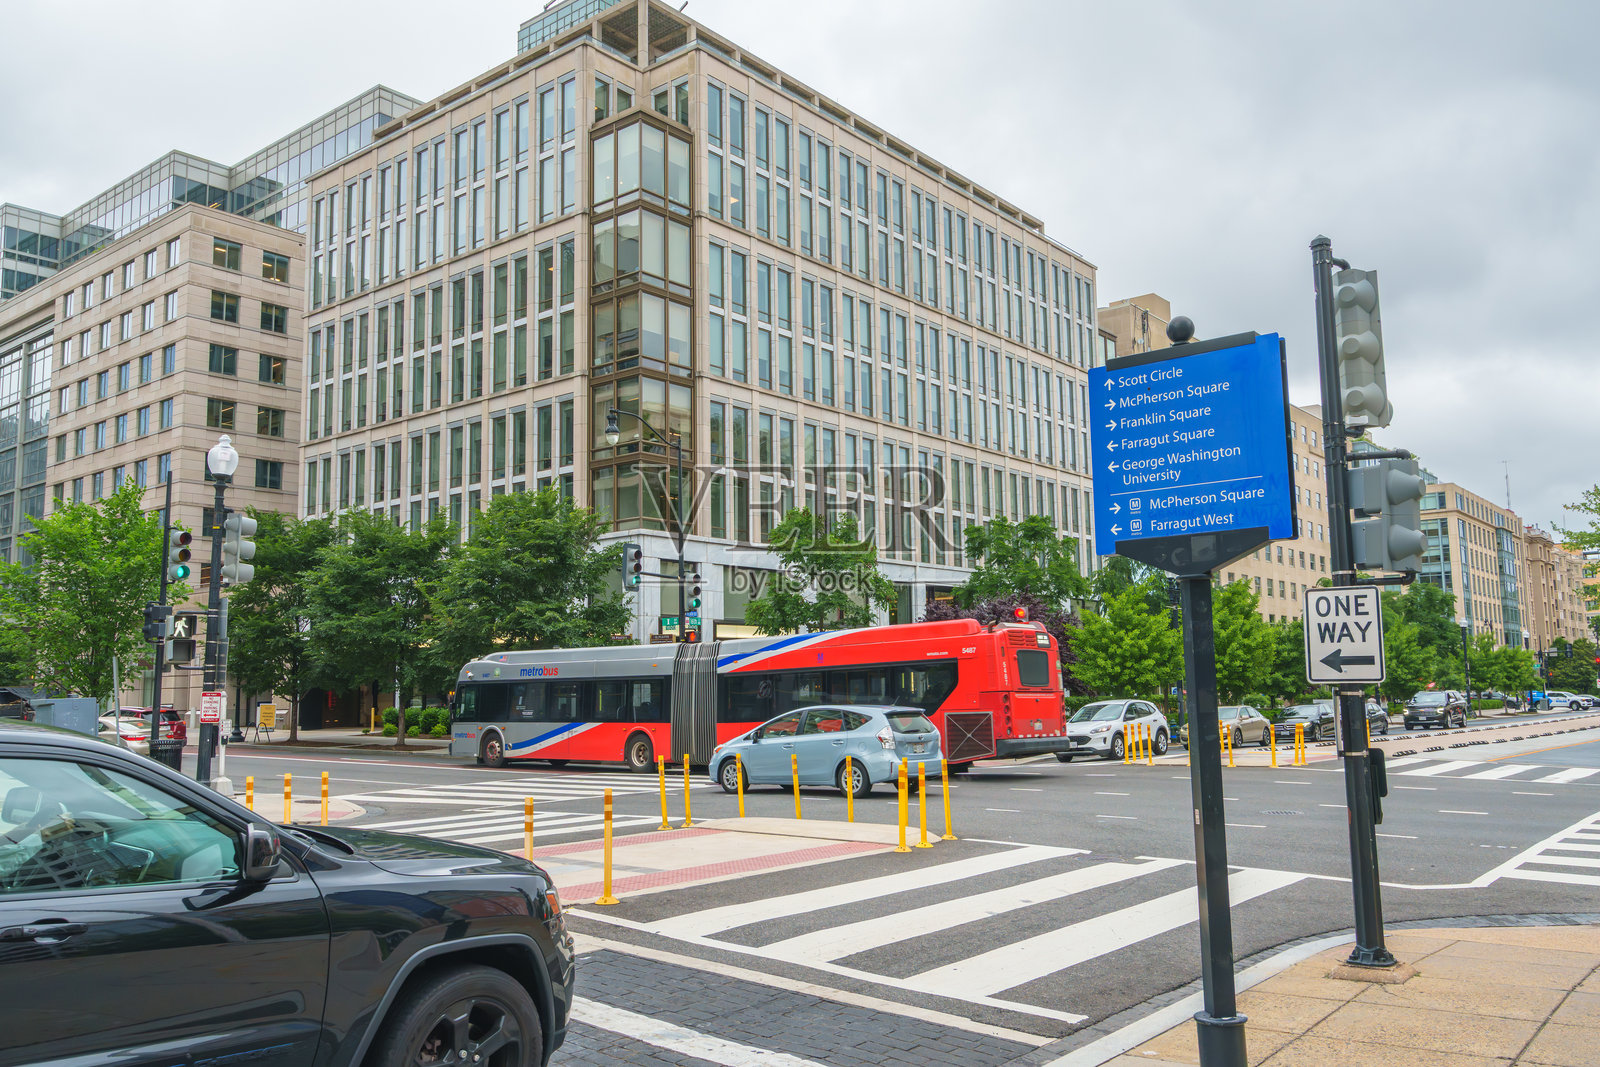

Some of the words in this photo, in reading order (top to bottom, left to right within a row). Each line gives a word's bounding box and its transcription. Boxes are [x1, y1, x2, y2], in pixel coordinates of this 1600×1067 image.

[1118, 375, 1148, 388] Scott
[1150, 366, 1184, 382] Circle
[1119, 390, 1184, 409] McPherson
[1187, 381, 1230, 399] Square
[1120, 412, 1166, 430] Franklin
[1169, 406, 1212, 423] Square
[1121, 432, 1170, 450] Farragut
[1172, 427, 1216, 444] Square
[1122, 457, 1166, 472] George
[1167, 445, 1241, 465] Washington
[1122, 469, 1182, 486] University
[1149, 495, 1217, 510] McPherson
[1220, 487, 1265, 504] Square
[1150, 516, 1202, 532] Farragut
[1203, 512, 1235, 527] West
[1315, 594, 1370, 618] ONE
[1317, 621, 1372, 643] WAY
[519, 665, 559, 677] metrobus
